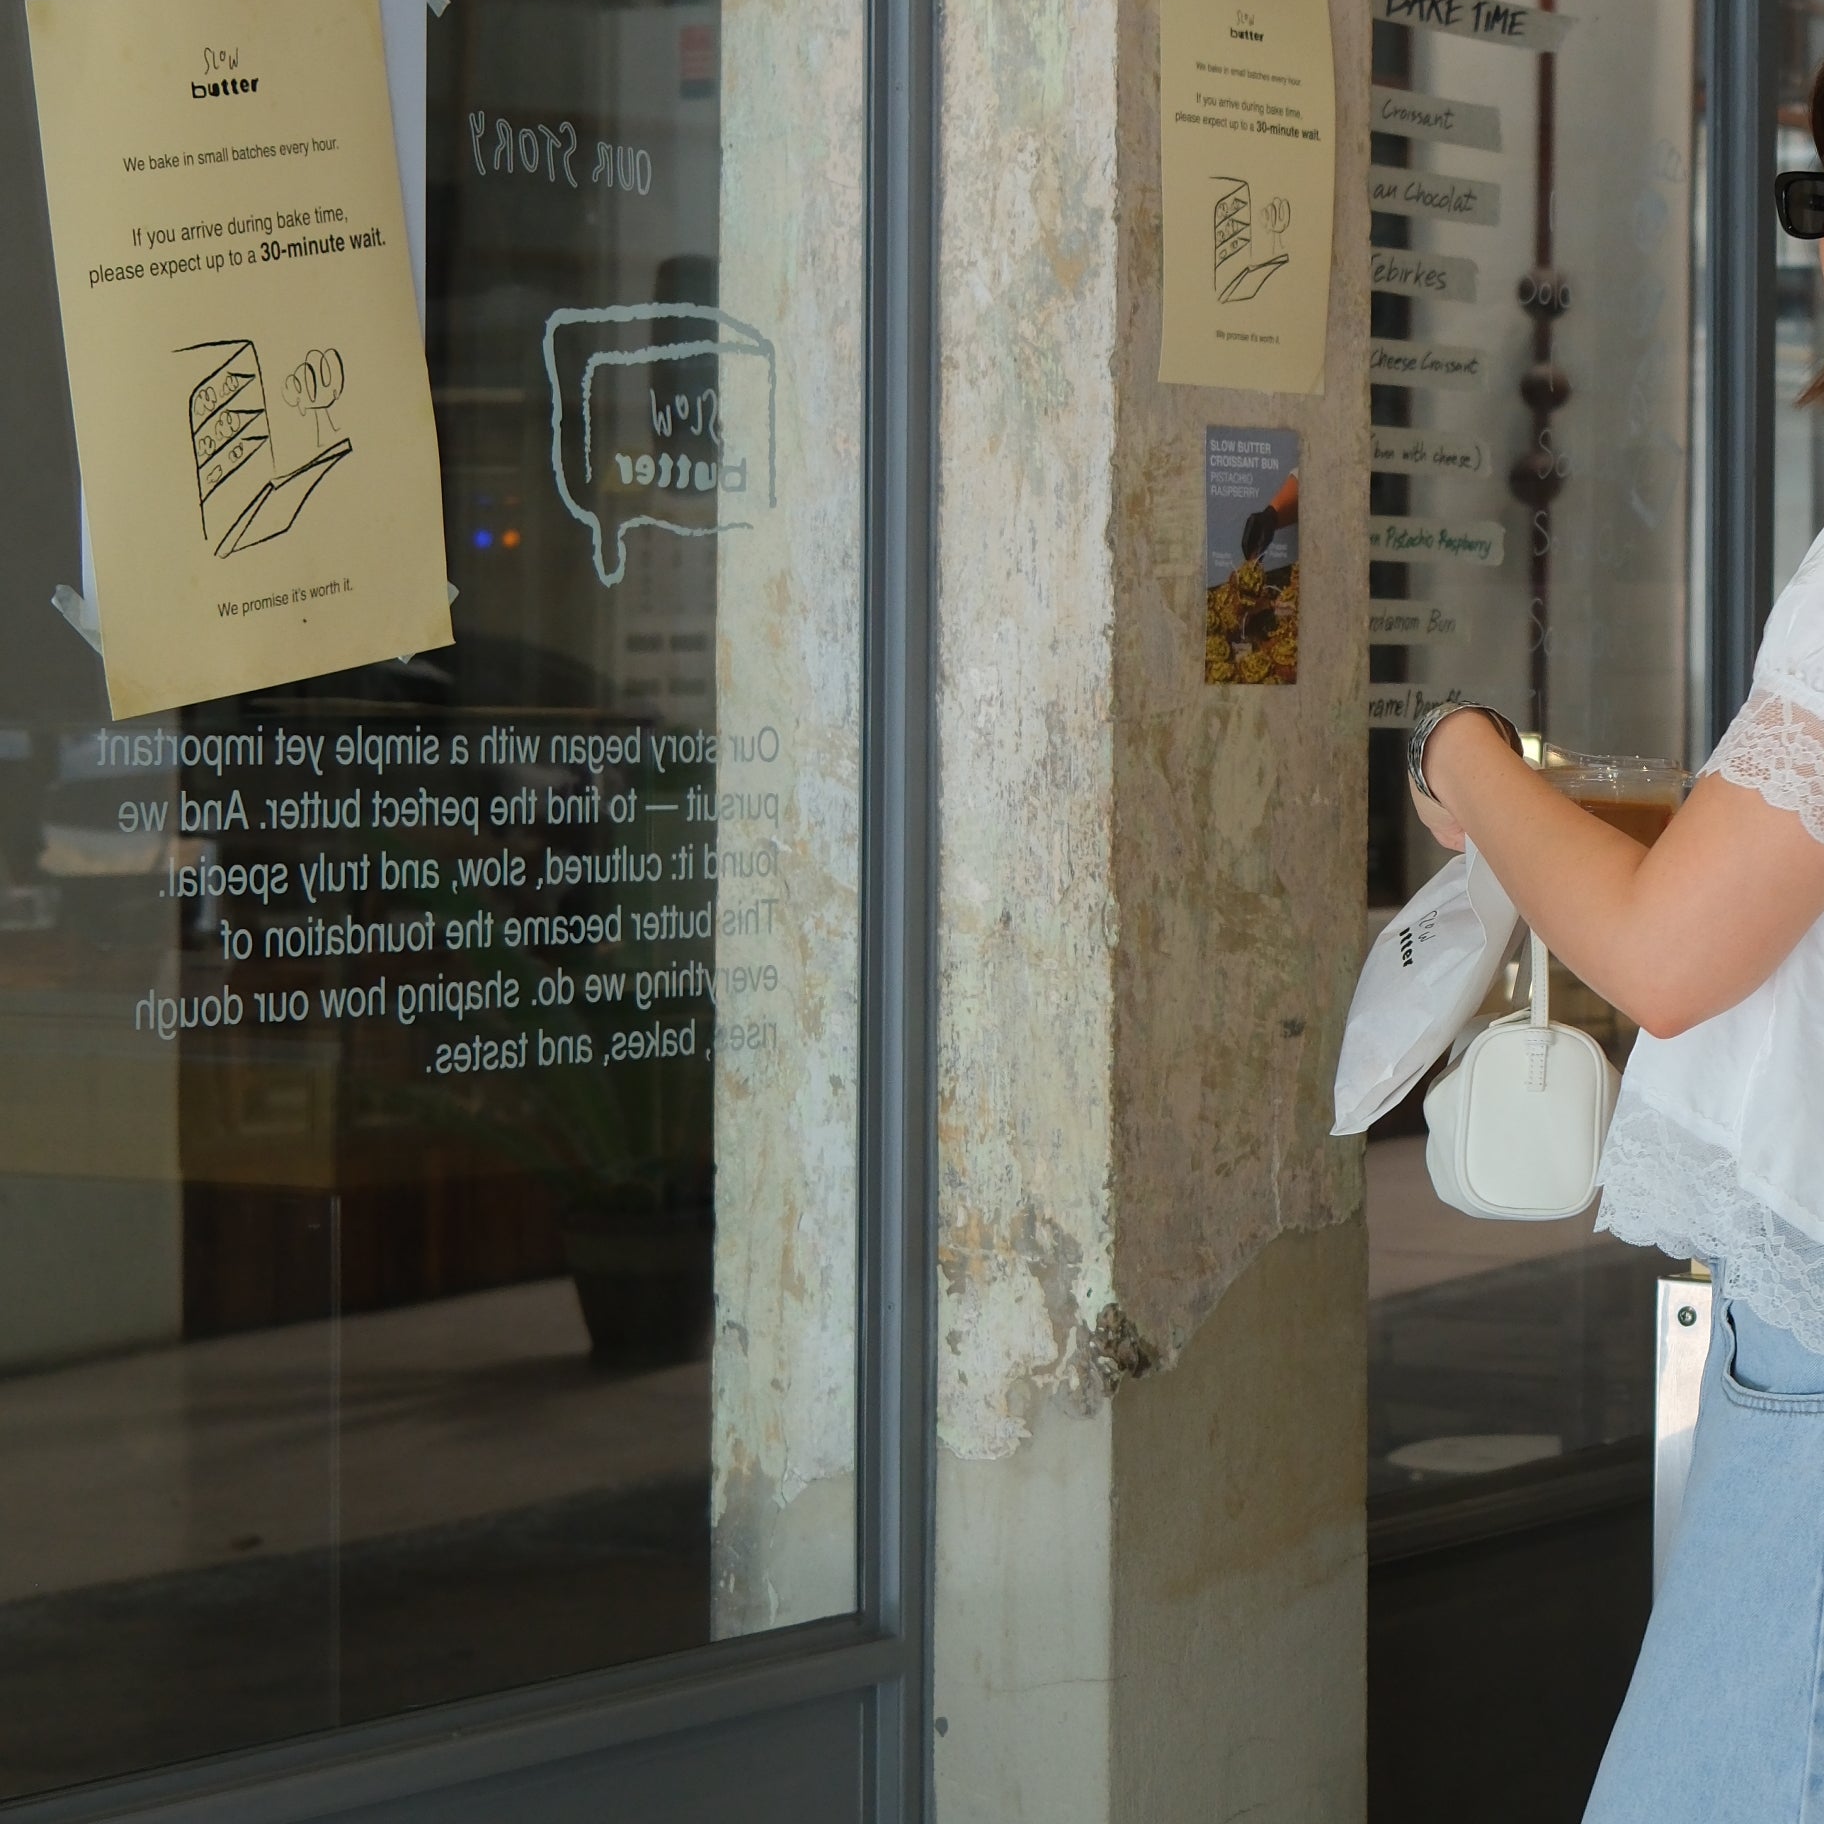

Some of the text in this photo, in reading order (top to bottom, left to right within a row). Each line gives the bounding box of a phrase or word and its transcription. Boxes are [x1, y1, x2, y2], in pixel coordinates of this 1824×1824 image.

[1472, 0, 1528, 36] TIME
[1230, 27, 1264, 42] butter
[191, 77, 259, 98] butter
[1196, 92, 1202, 104] If
[1203, 95, 1217, 107] you
[1218, 97, 1240, 110] arrive
[1241, 99, 1265, 116] during
[1266, 103, 1284, 117] bake
[1382, 98, 1455, 129] Croissant
[1175, 110, 1201, 125] please
[1202, 115, 1228, 129] expect
[1229, 119, 1239, 131] up
[1240, 119, 1249, 131] to
[1256, 120, 1300, 138] 30-minute
[1301, 127, 1321, 142] wait.
[123, 138, 339, 172] We bake in small batches every hour.
[1404, 182, 1477, 213] Chocolat
[132, 206, 348, 249] If you arrive during bake time,
[89, 226, 387, 288] please expect up to a 30-minute wait.
[1370, 347, 1479, 374] Cheese Croissant
[1210, 439, 1271, 454] SLOW BUTTER
[1371, 433, 1394, 459] bun
[1402, 440, 1426, 463] with
[1210, 455, 1279, 470] CROISSANT BUN
[1386, 526, 1434, 551] Pistachio
[1439, 528, 1492, 560] Raspberry
[217, 577, 353, 617] We promise it's worth it.
[1427, 609, 1456, 634] Bun
[1369, 689, 1411, 717] ramel
[1399, 927, 1413, 967] tter
